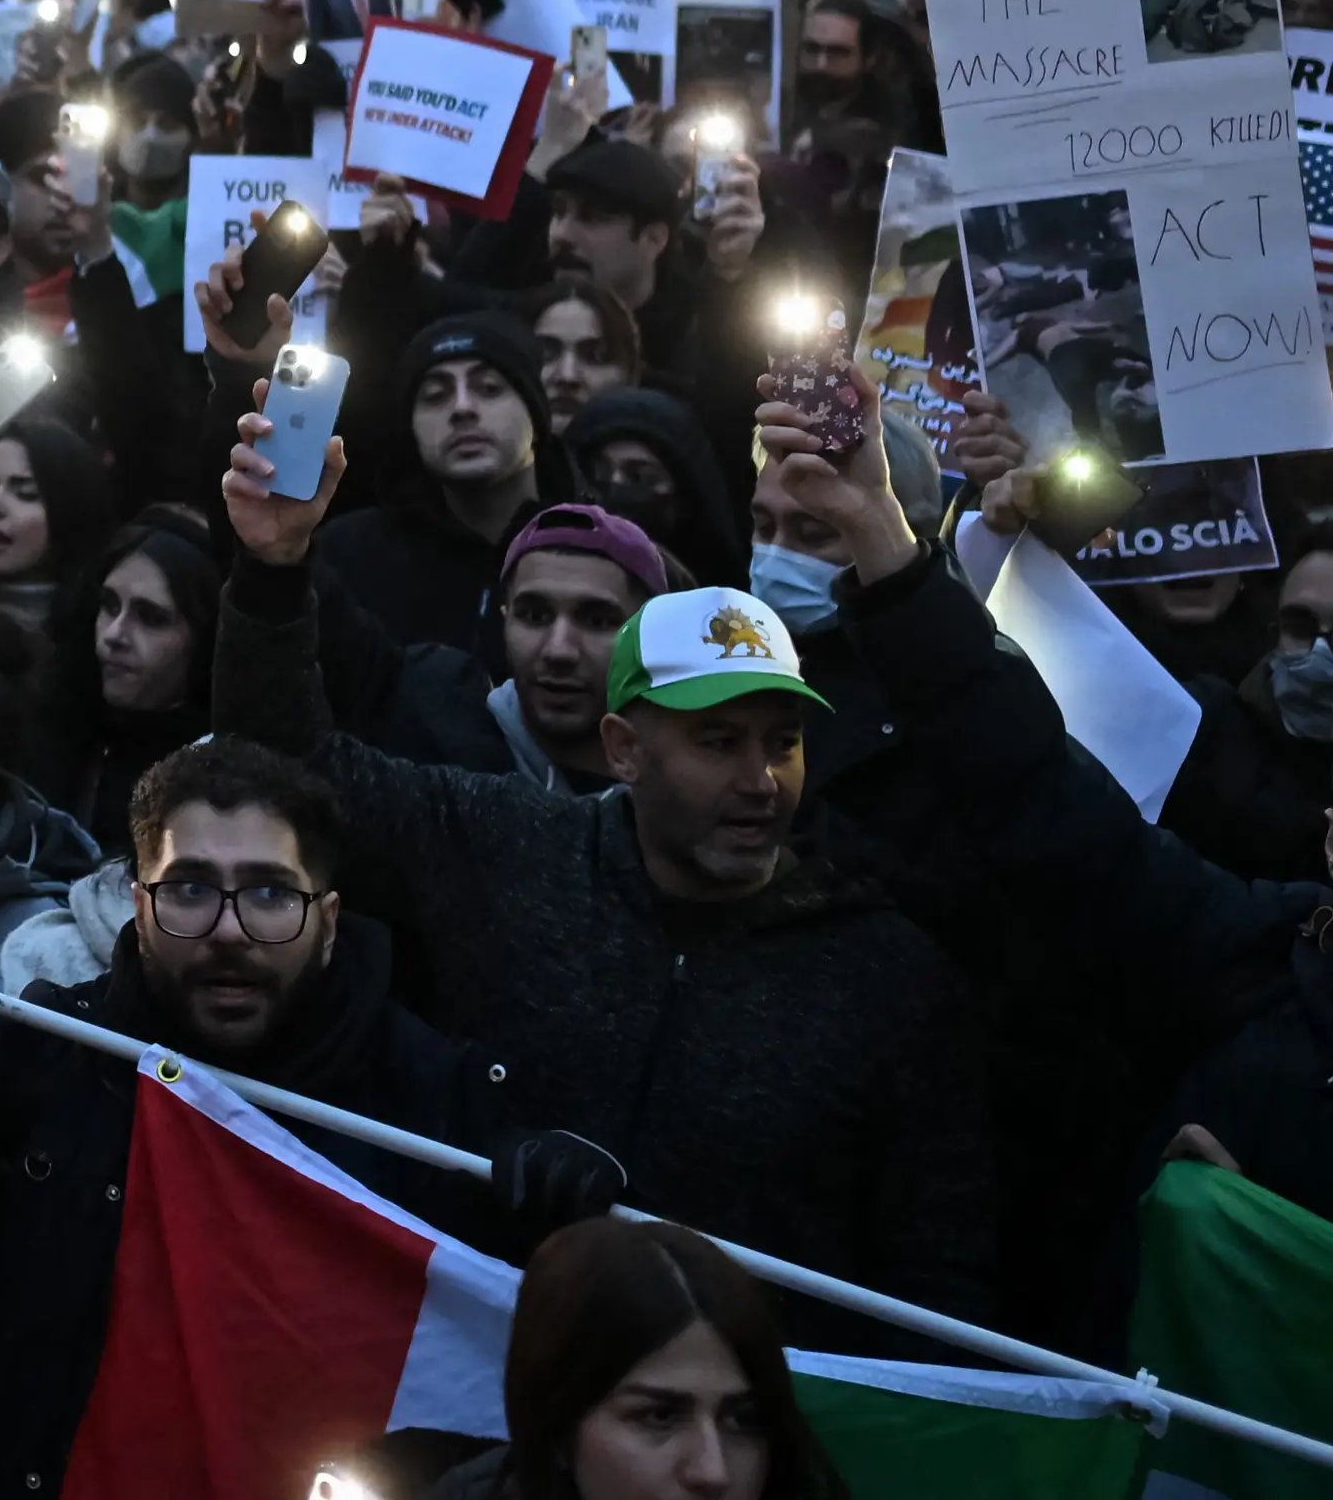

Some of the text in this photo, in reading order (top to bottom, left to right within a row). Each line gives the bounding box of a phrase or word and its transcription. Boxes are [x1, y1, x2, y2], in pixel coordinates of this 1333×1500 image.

[946, 44, 1126, 92] MASSACRE
[457, 98, 489, 121] ACT
[223, 180, 287, 202] YOUR
[1150, 194, 1270, 267] ACT
[1165, 306, 1313, 372] NOW!
[1116, 528, 1164, 558] LO
[1169, 508, 1259, 551] SCIÀ
